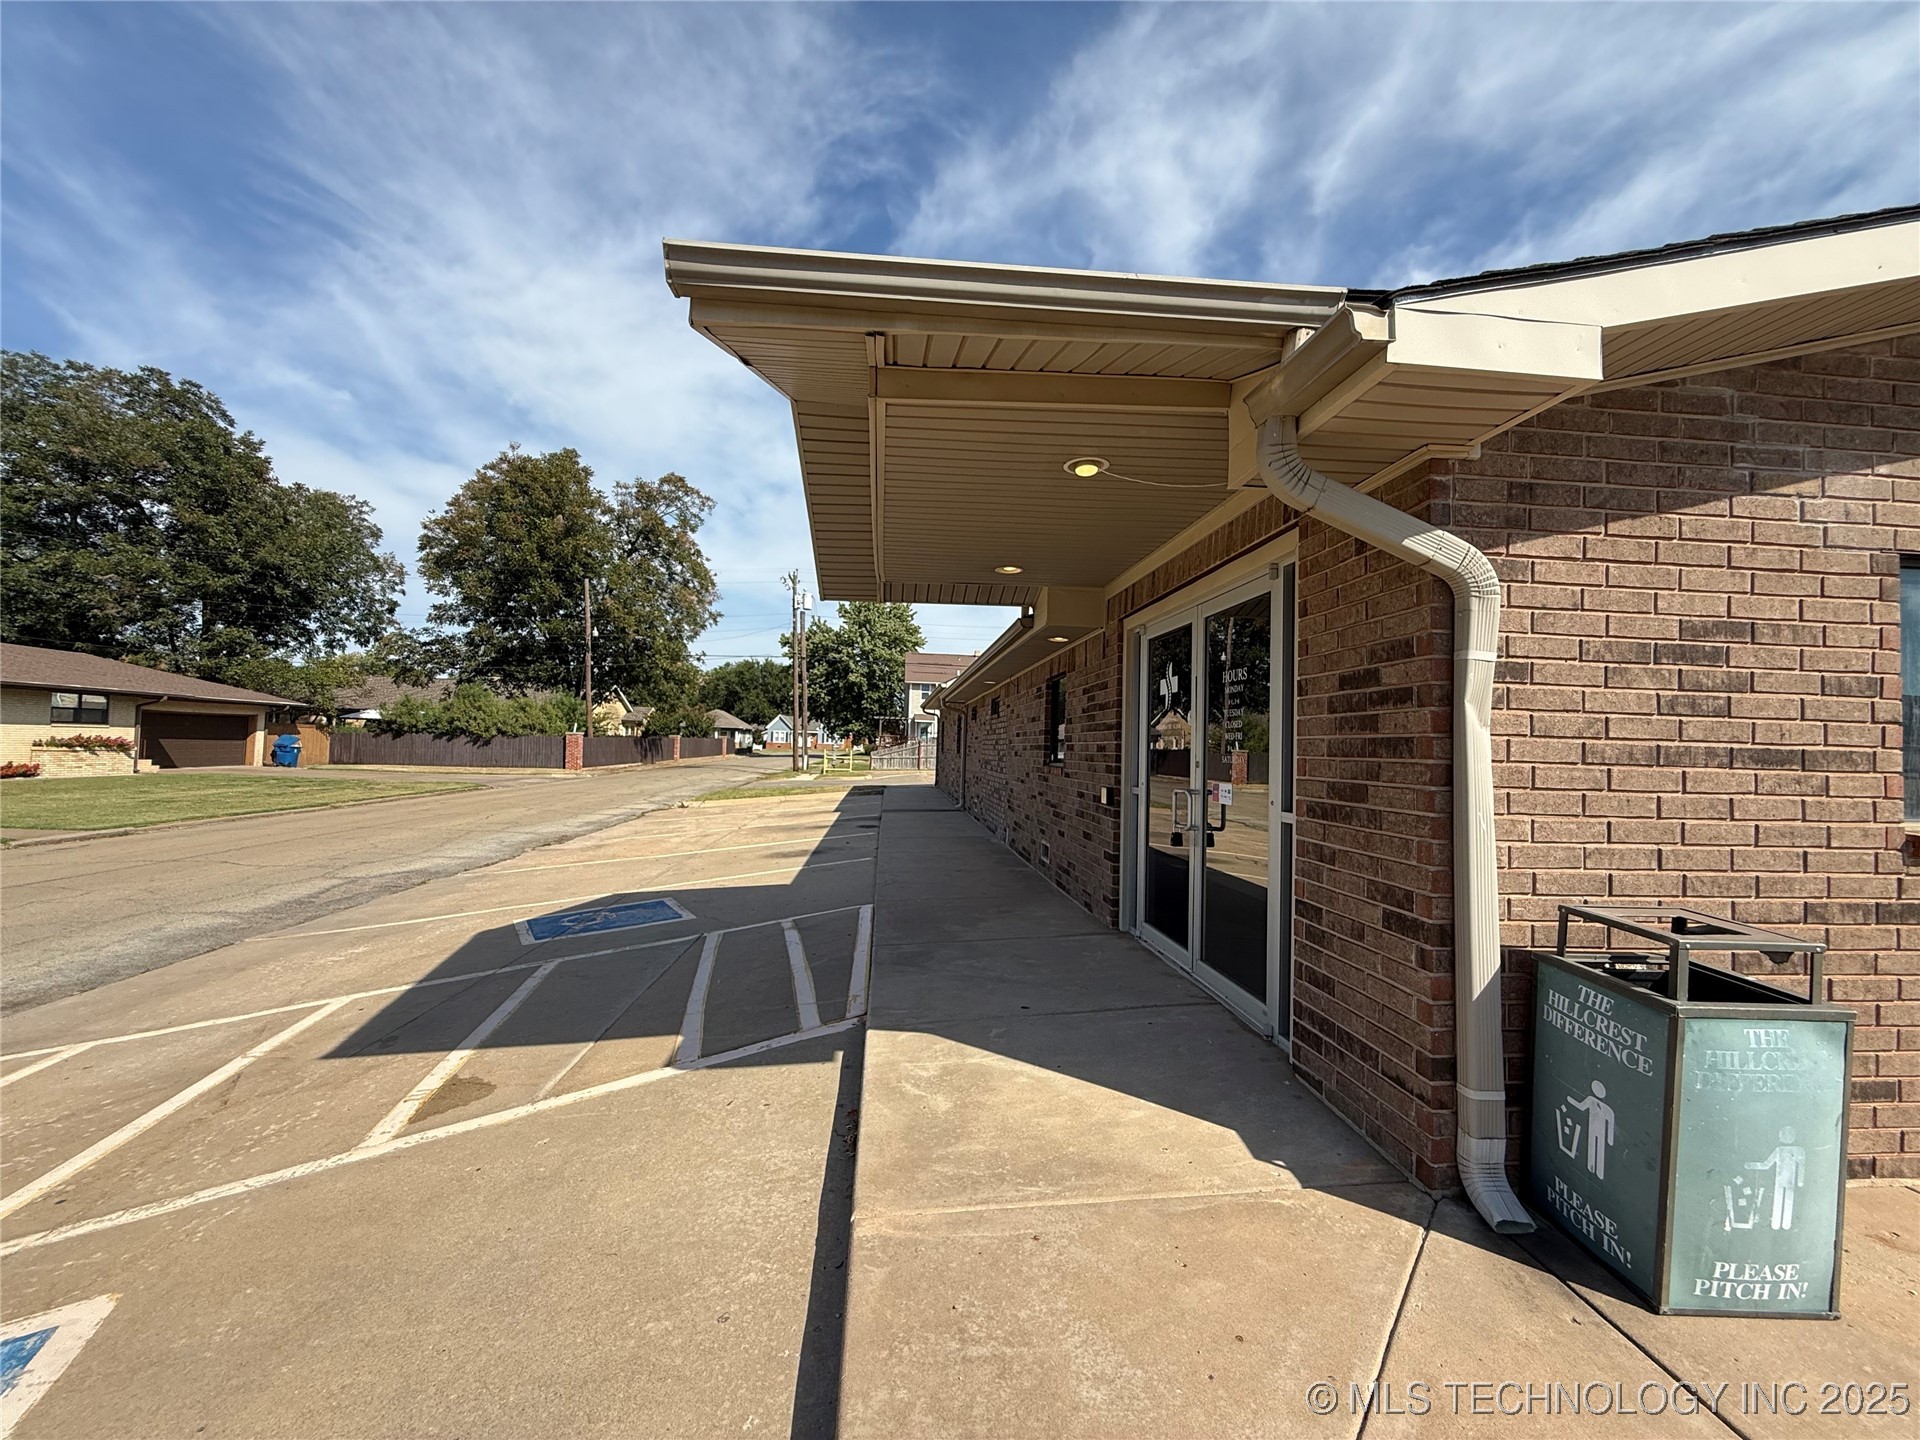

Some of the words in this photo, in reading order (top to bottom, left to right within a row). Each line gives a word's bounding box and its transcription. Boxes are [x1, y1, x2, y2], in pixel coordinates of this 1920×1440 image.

[1222, 667, 1248, 683] HOURS
[1224, 684, 1244, 694] MONDAY
[1223, 707, 1244, 717] TUESDAY
[1224, 720, 1243, 729] CLOSED
[1224, 732, 1243, 741] WED-FRI
[1577, 984, 1615, 1016] THE
[1547, 989, 1648, 1052] HILLCREST
[1542, 1004, 1654, 1078] DIFFERENCE
[1743, 1028, 1790, 1049] THE
[1554, 1175, 1619, 1240] PLEASE
[1546, 1184, 1595, 1240] PITCH
[1602, 1235, 1633, 1270] IN!
[1713, 1261, 1800, 1281] PLEASE
[1692, 1279, 1769, 1300] PITCH
[1777, 1281, 1809, 1300] IN!
